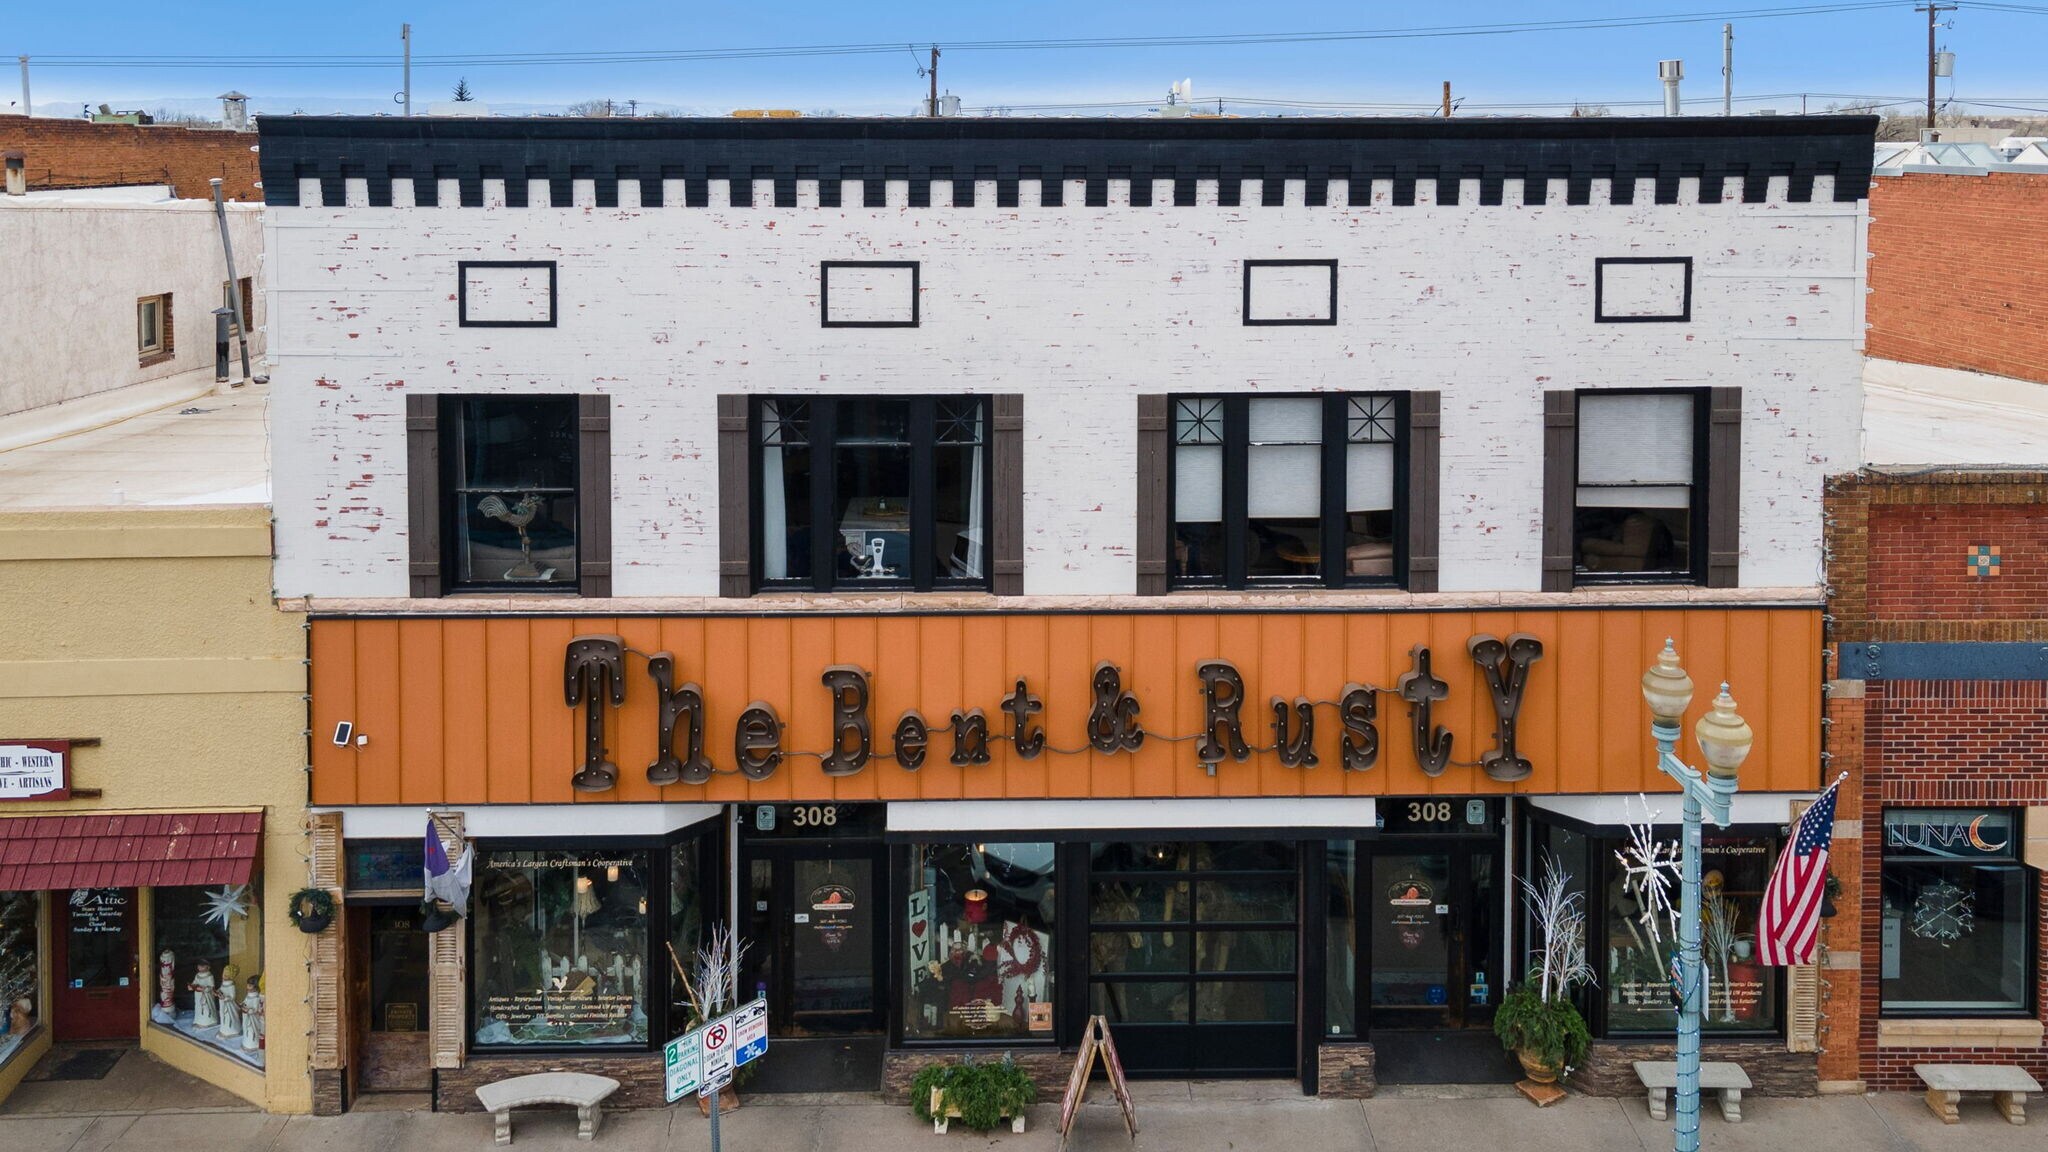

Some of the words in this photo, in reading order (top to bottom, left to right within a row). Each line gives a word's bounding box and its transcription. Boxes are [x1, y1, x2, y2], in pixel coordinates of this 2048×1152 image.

[564, 634, 782, 793] The
[822, 664, 1043, 777] Bent
[1087, 660, 1145, 755] &
[22, 756, 54, 768] WESTERN
[18, 777, 52, 788] ARTISANS
[793, 806, 837, 826] 308
[1408, 802, 1452, 822] 308
[1888, 822, 1971, 847] LUNA
[1726, 846, 1766, 856] Cooperative
[487, 858, 521, 869] America's
[523, 860, 548, 869] Largest
[550, 859, 591, 869] Craftsman's
[593, 859, 633, 869] Cooperative
[76, 894, 128, 906] Attic
[669, 1048, 676, 1064] 2
[678, 1045, 698, 1057] PARKING
[670, 1058, 698, 1077] DIAGONAL
[677, 1072, 691, 1084] ONLY
